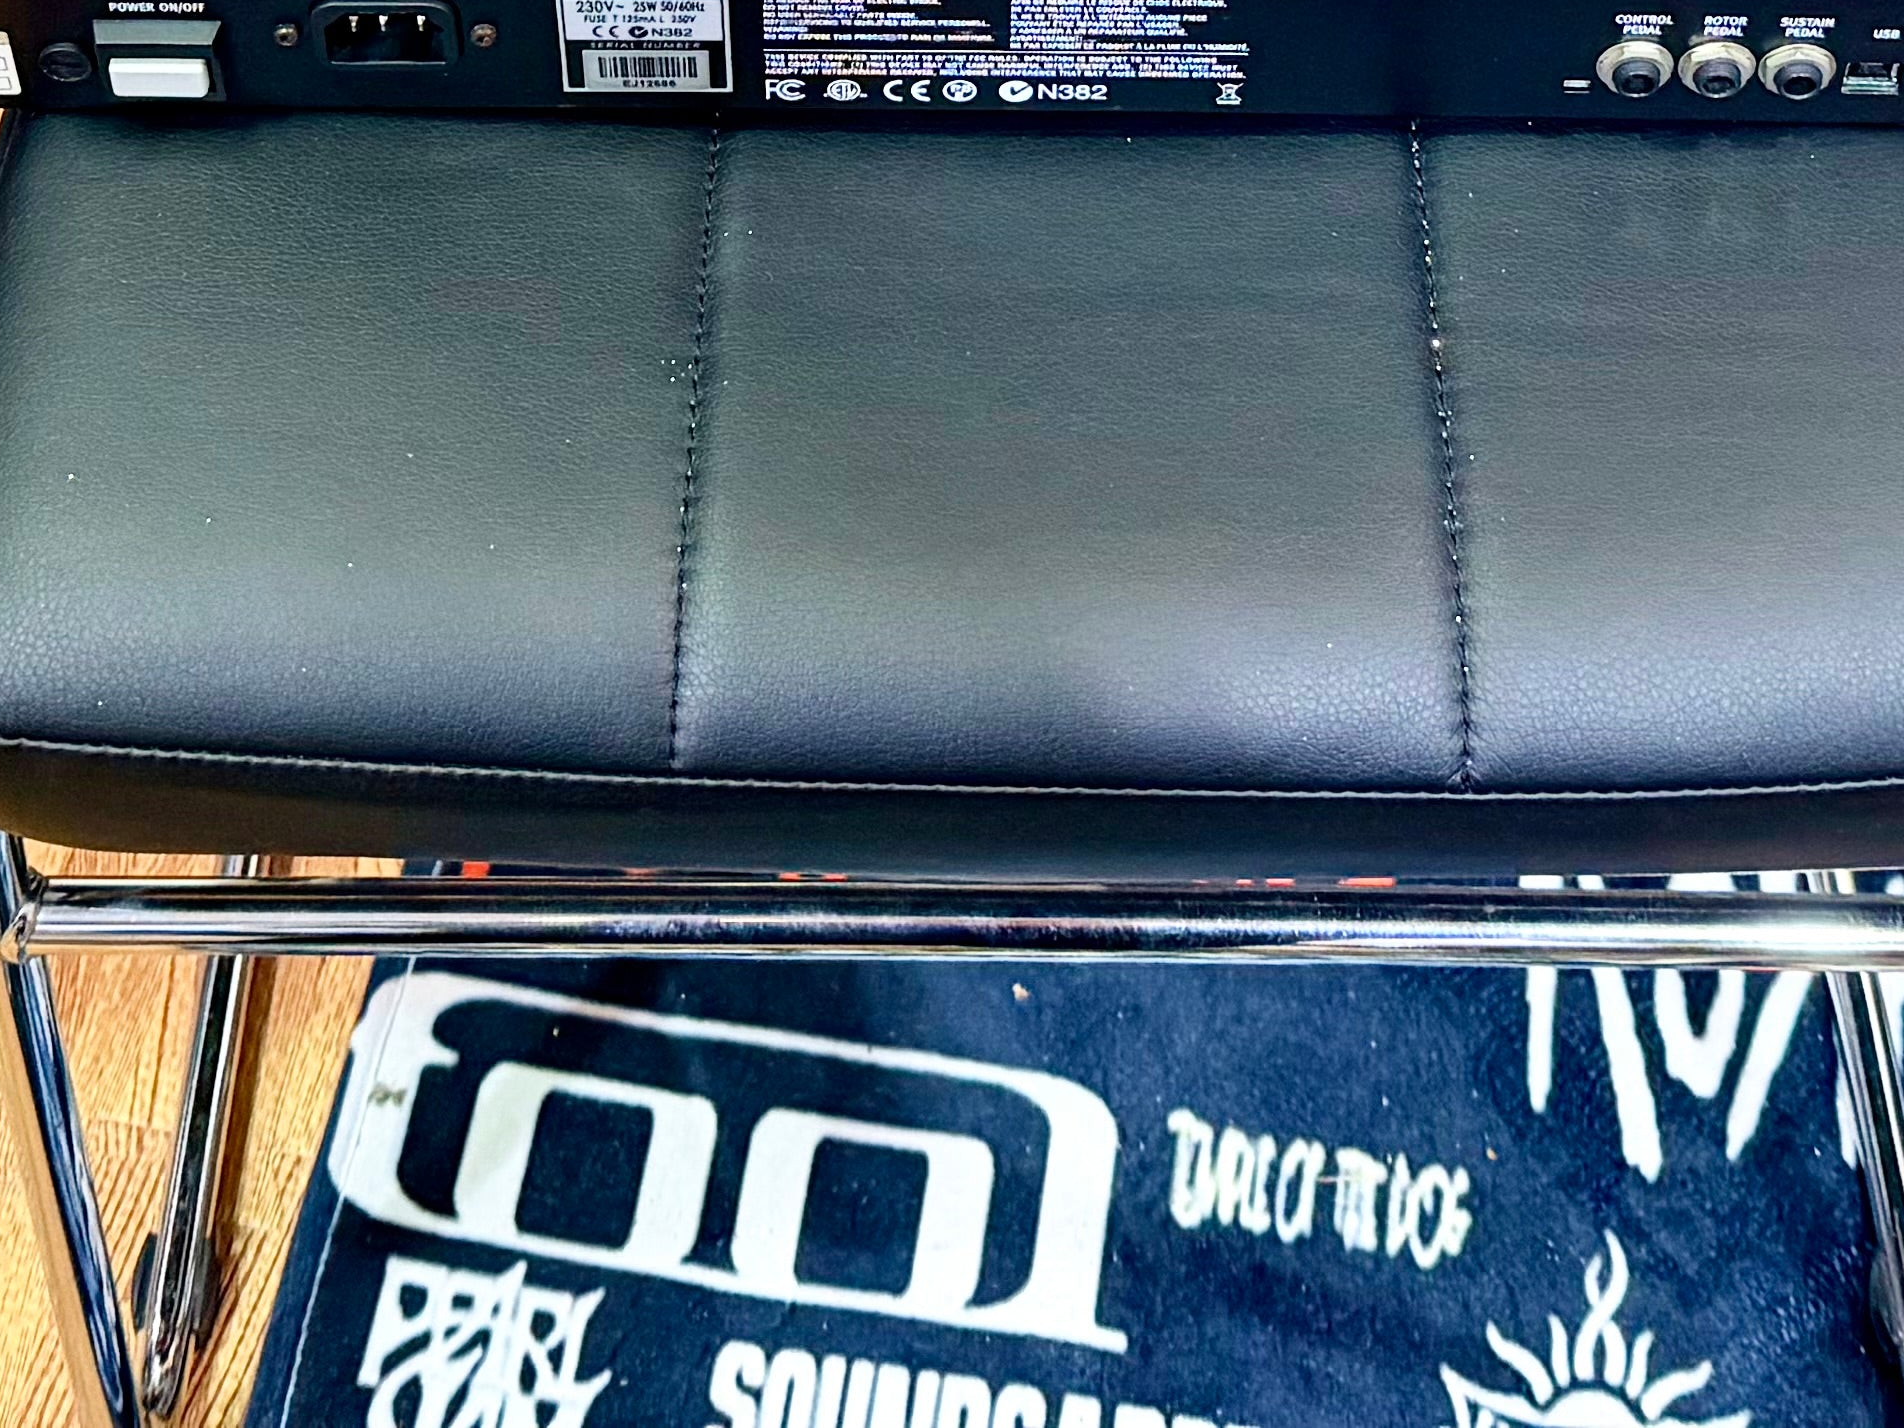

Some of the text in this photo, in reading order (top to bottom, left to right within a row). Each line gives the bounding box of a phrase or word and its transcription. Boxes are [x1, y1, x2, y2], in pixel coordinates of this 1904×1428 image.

[108, 2, 205, 13] POWER ON/OFF
[633, 1, 657, 12] 25W
[661, 1, 705, 12] 50/60Hz
[1616, 14, 1673, 26] CONTROL
[1703, 16, 1748, 27] ROTOR
[1780, 16, 1836, 28] SUSTAIN
[652, 28, 693, 37] N382
[1622, 25, 1662, 36] PEDAL
[1703, 26, 1744, 38] PEDAL
[1784, 26, 1826, 38] PEDAL
[1873, 29, 1900, 40] USB
[1037, 84, 1108, 101] N382
